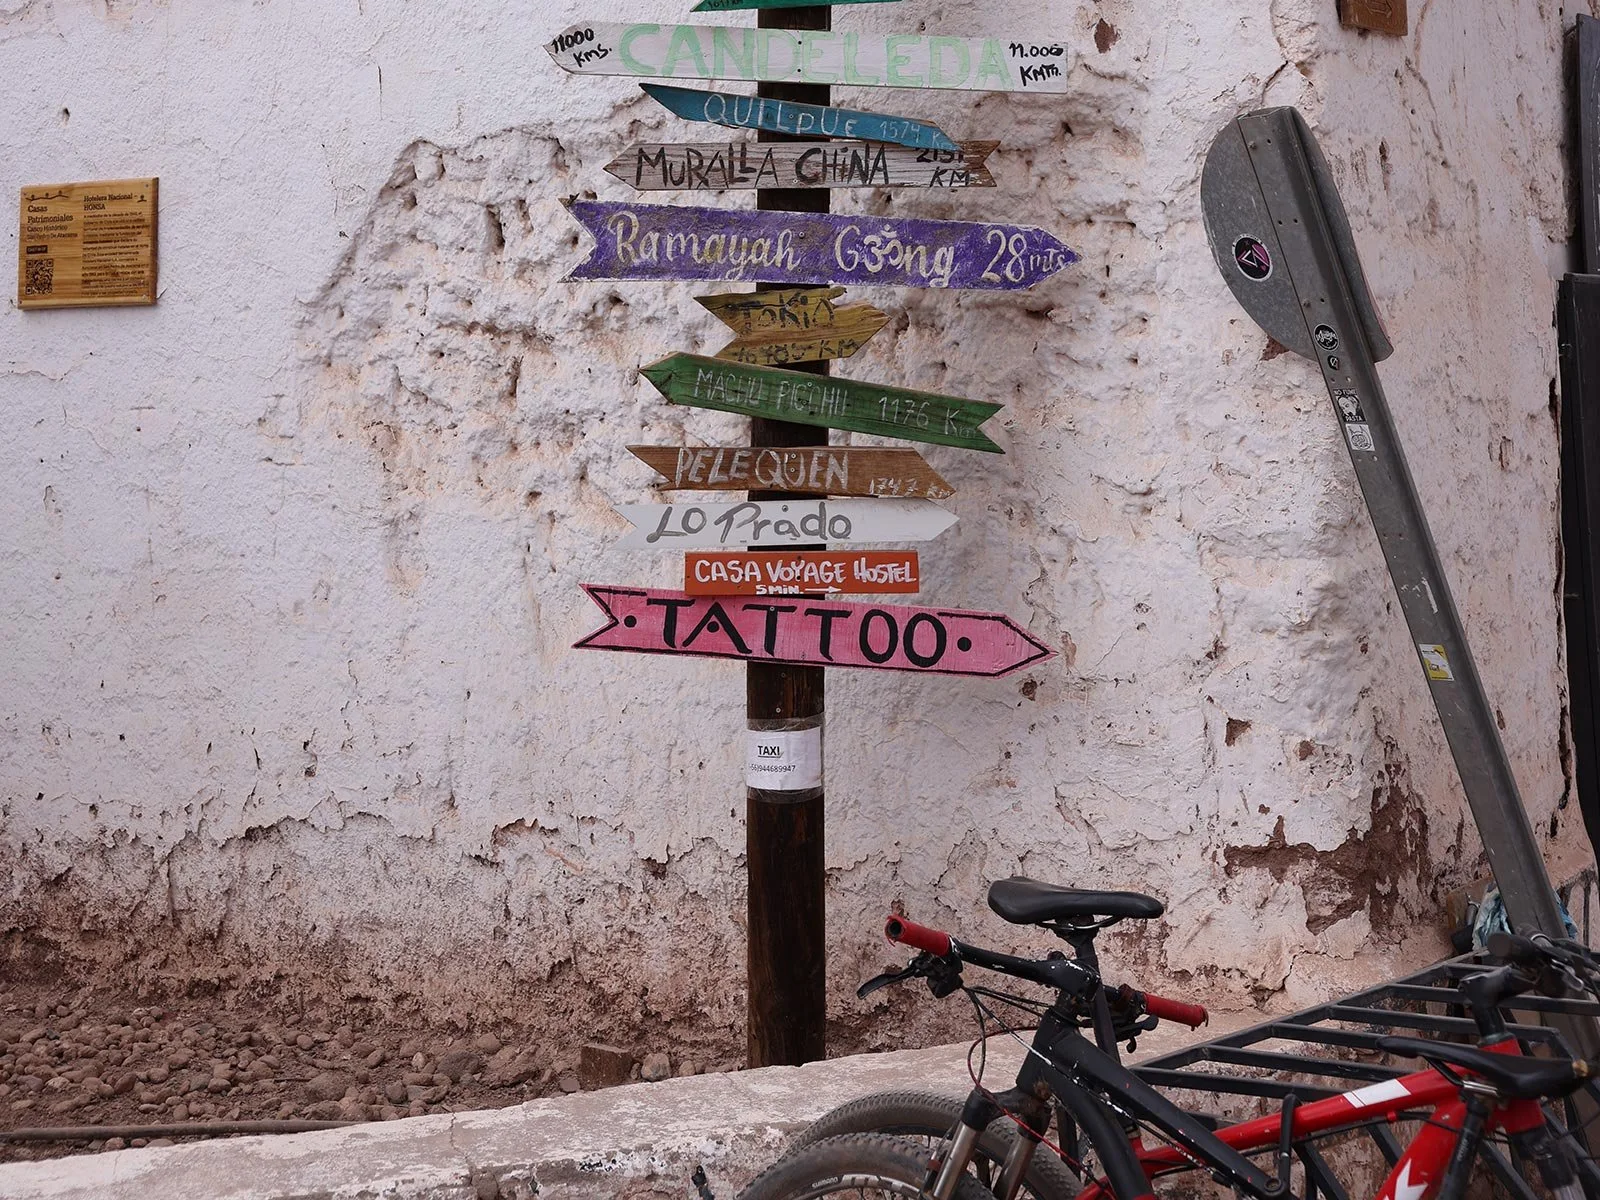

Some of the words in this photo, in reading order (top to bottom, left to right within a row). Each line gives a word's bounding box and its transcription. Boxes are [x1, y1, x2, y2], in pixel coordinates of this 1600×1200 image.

[551, 28, 595, 54] 11000
[619, 23, 1014, 91] CANDELEDA
[930, 166, 971, 188] KM
[27, 214, 74, 224] Patrimoniales
[609, 210, 801, 272] Ramayah
[980, 229, 1028, 284] 28
[695, 368, 763, 406] MACHU
[879, 396, 931, 428] 1176
[646, 504, 708, 544] LO
[713, 501, 854, 544] Prado
[695, 559, 762, 583] CASA
[766, 559, 848, 584] VOYAGE
[853, 557, 918, 584] HOSTEL
[646, 598, 948, 669] TATTOO
[758, 745, 781, 757] TAXI
